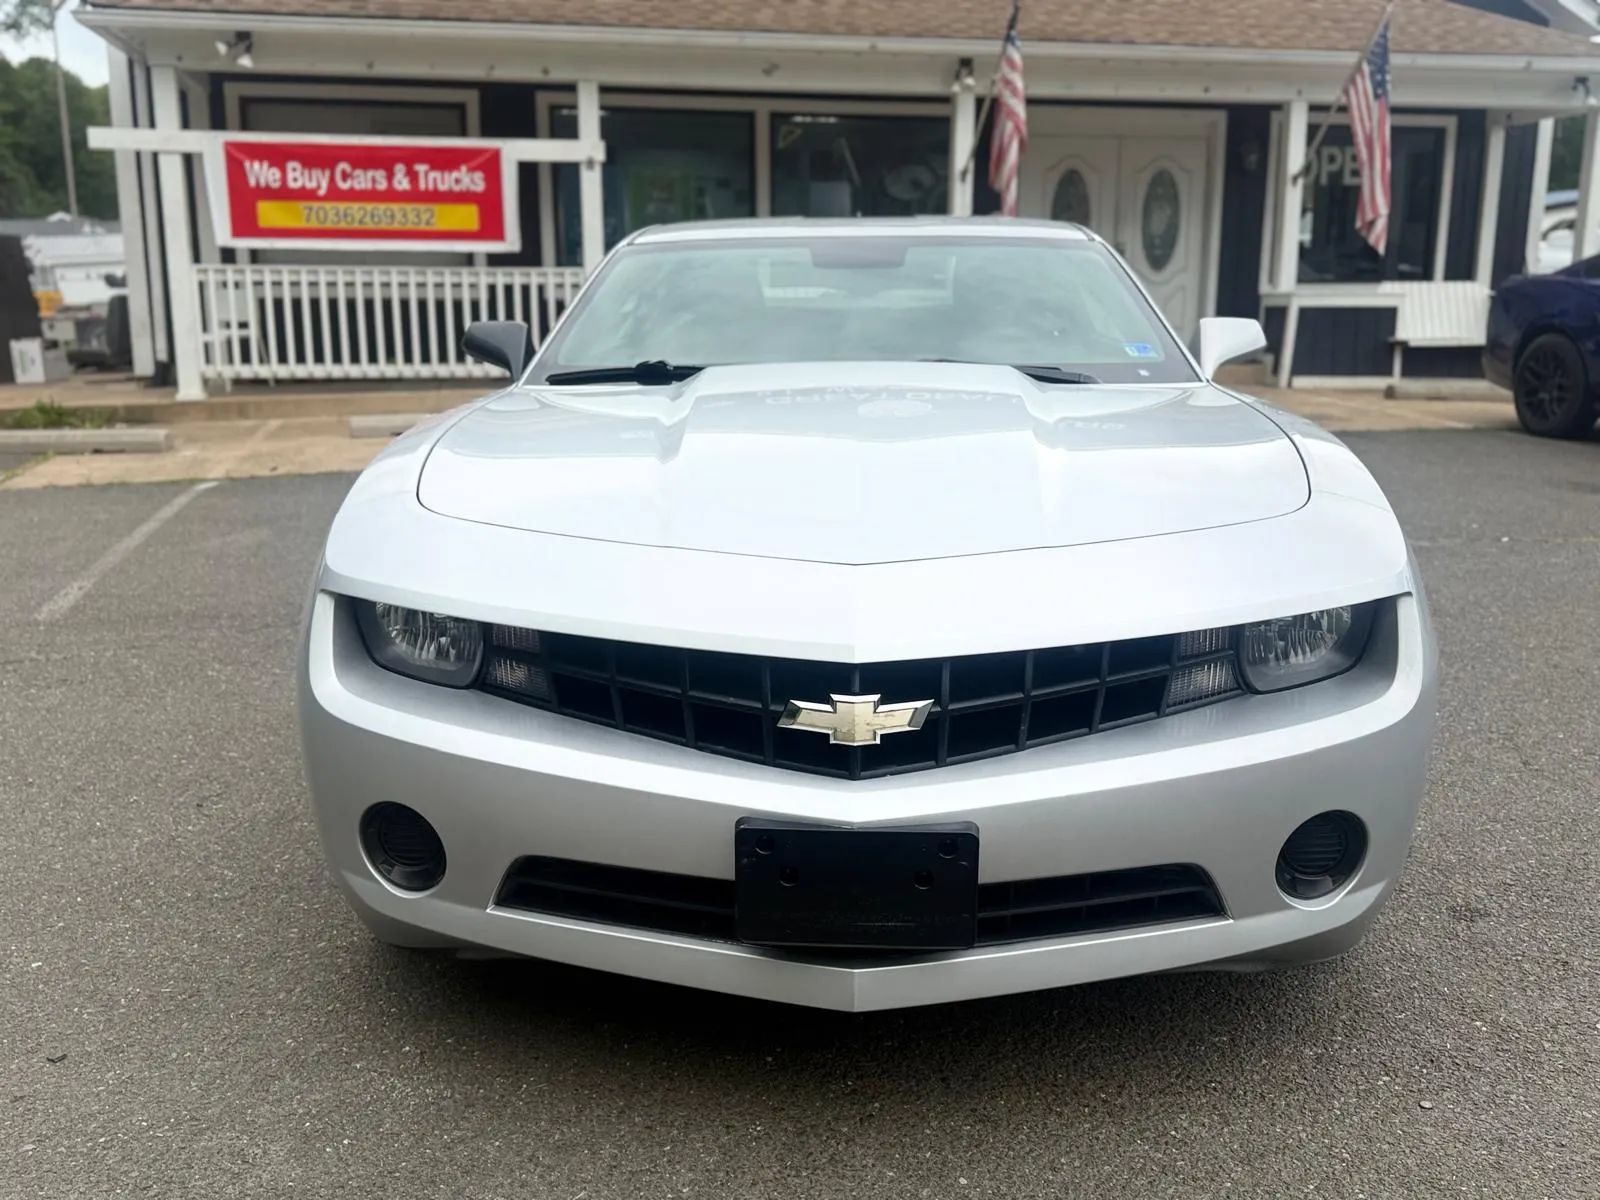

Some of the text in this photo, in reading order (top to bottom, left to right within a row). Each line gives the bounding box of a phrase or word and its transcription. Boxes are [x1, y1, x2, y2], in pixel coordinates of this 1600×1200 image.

[243, 160, 486, 196] We Buy Cars & Trucks
[1303, 146, 1362, 186] OPE
[303, 205, 436, 226] 7036269332
